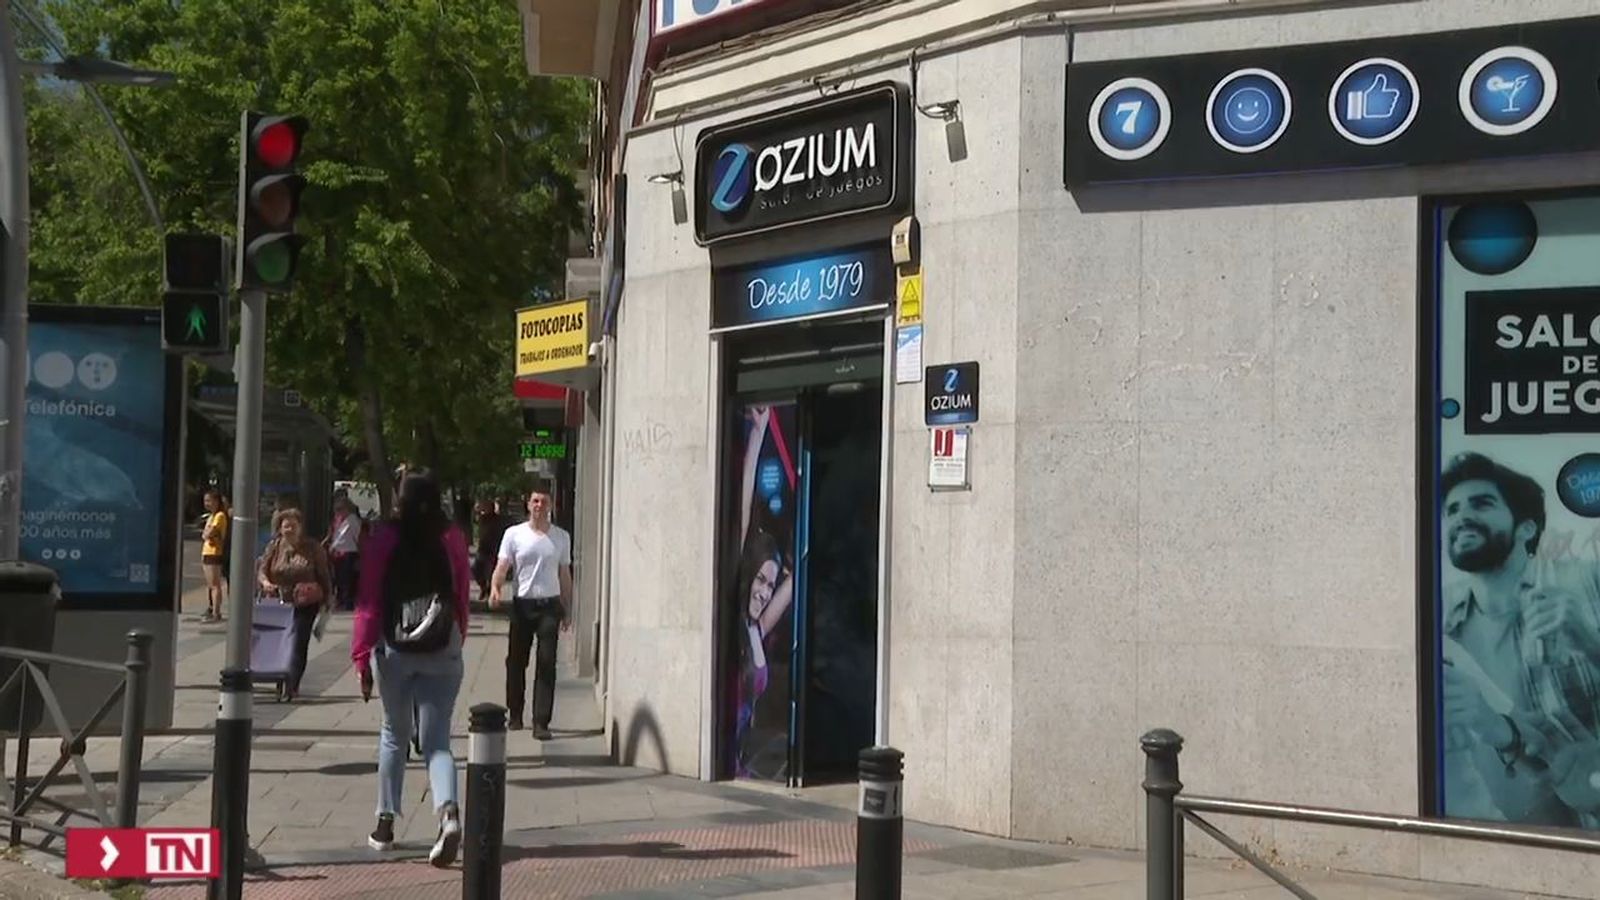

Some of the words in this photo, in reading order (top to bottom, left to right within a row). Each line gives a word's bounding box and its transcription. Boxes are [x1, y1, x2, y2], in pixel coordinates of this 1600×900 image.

[747, 267, 811, 309] Desde
[818, 260, 864, 301] 1979
[520, 311, 584, 340] FOTOCOPIAS
[1562, 355, 1599, 374] DE
[22, 399, 116, 417] Telefónica
[18, 525, 40, 538] 00
